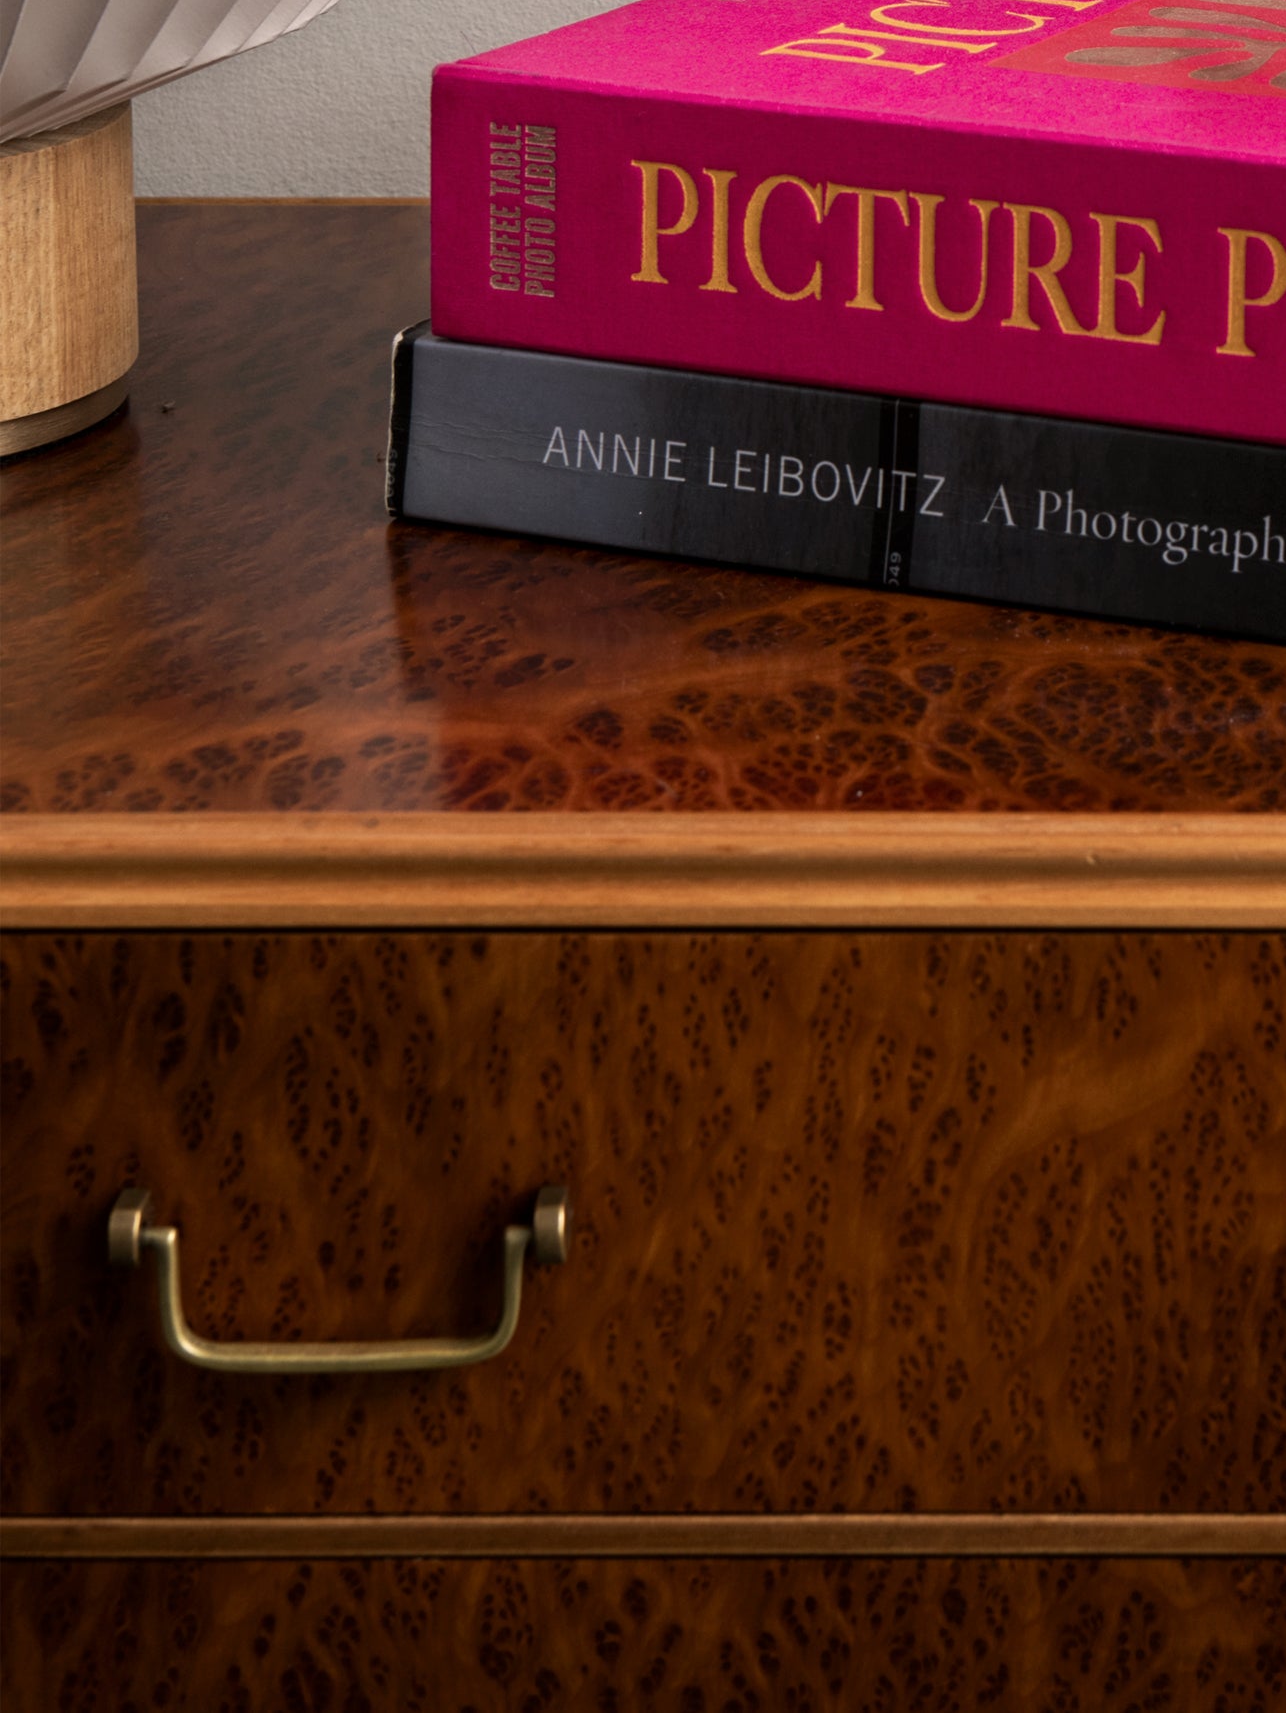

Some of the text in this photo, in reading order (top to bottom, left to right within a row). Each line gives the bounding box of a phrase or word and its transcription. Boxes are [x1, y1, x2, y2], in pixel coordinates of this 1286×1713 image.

[489, 121, 522, 292] COFFEE TABLE
[524, 124, 557, 298] PHOTO ALBUM
[630, 157, 1167, 346] PICTURE
[542, 425, 947, 518] ANNIE LEIBOVITZ
[980, 483, 1016, 528] A
